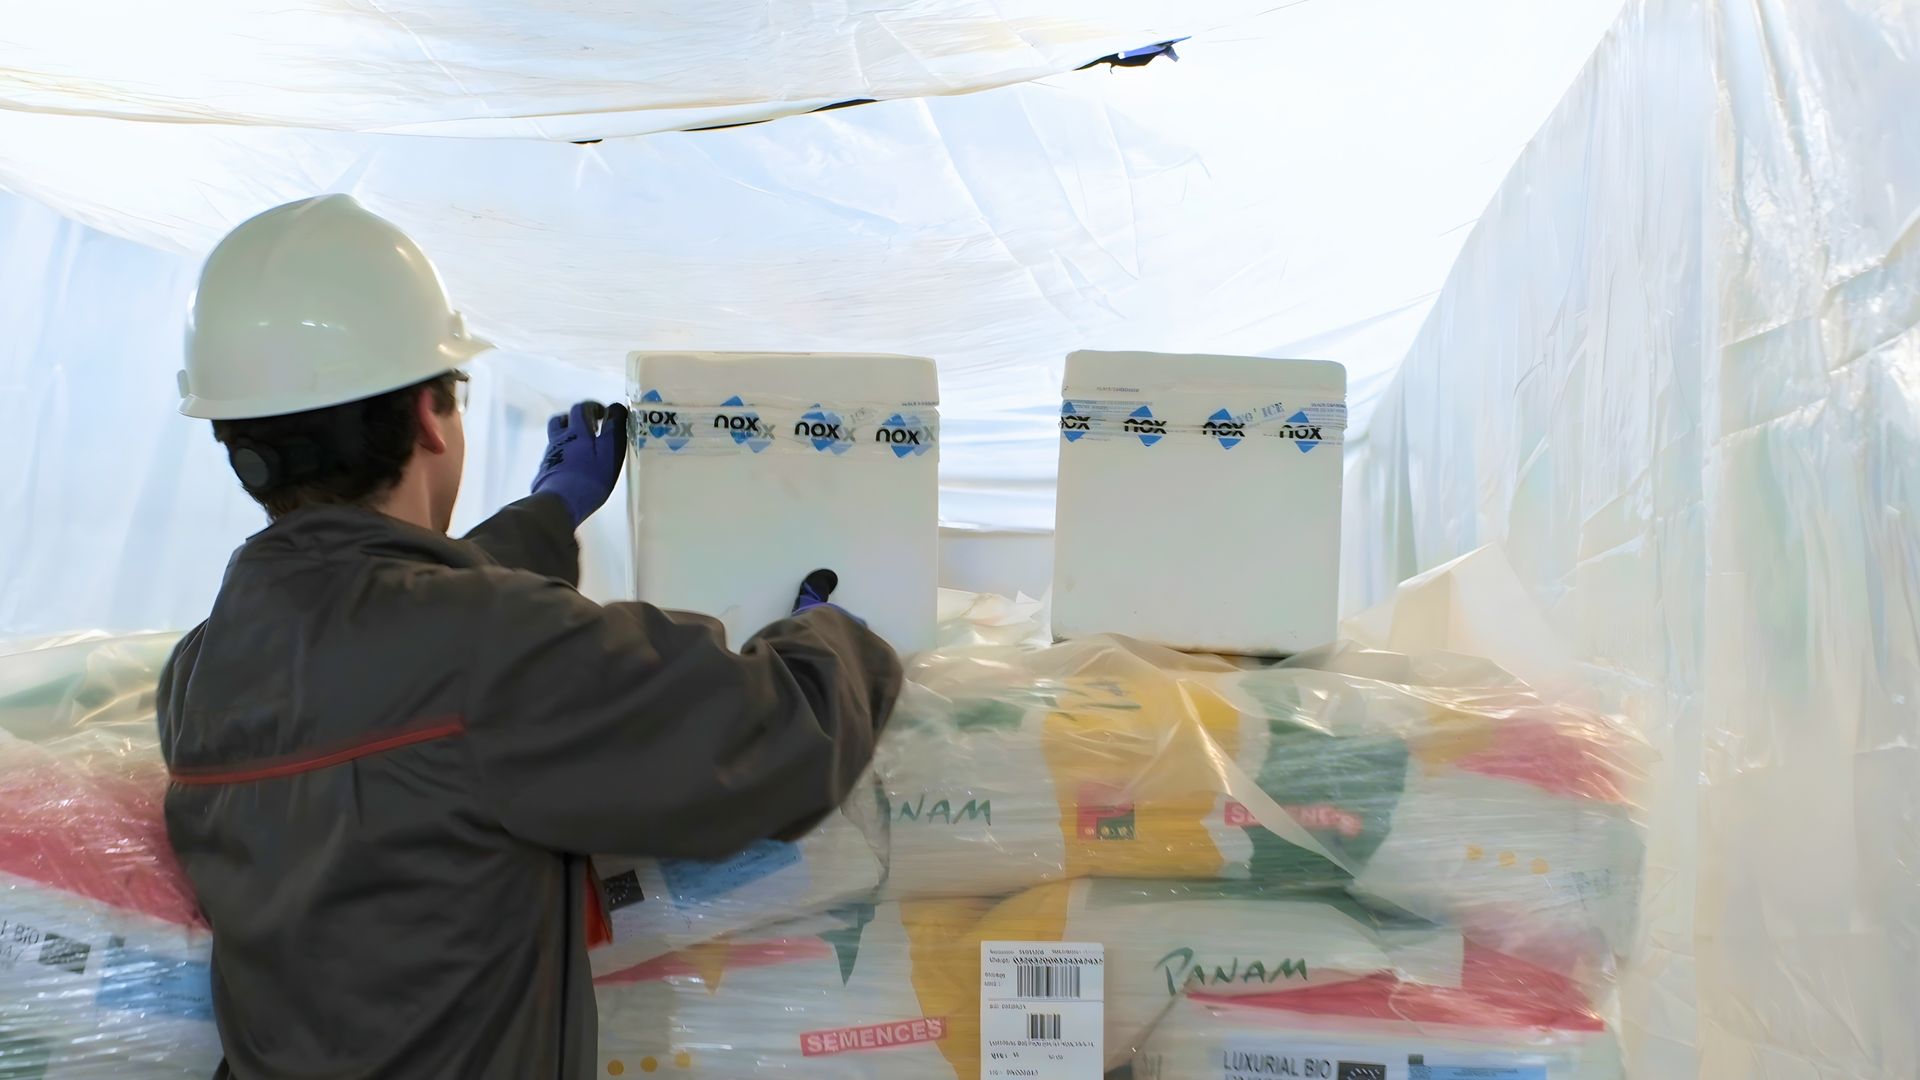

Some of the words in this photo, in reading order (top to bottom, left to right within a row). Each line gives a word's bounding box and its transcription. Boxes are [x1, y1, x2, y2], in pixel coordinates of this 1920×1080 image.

[714, 414, 760, 431] nox
[795, 421, 841, 439] nox
[876, 428, 920, 445] nox
[1123, 418, 1167, 434] nox
[1203, 421, 1246, 437] nox
[1280, 424, 1322, 440] nox
[899, 793, 991, 826] NAM
[1152, 947, 1308, 996] PANAM
[807, 1019, 942, 1053] SEMENCES
[1223, 1050, 1299, 1076] LUXURIAL
[1305, 1058, 1332, 1079] BIO
